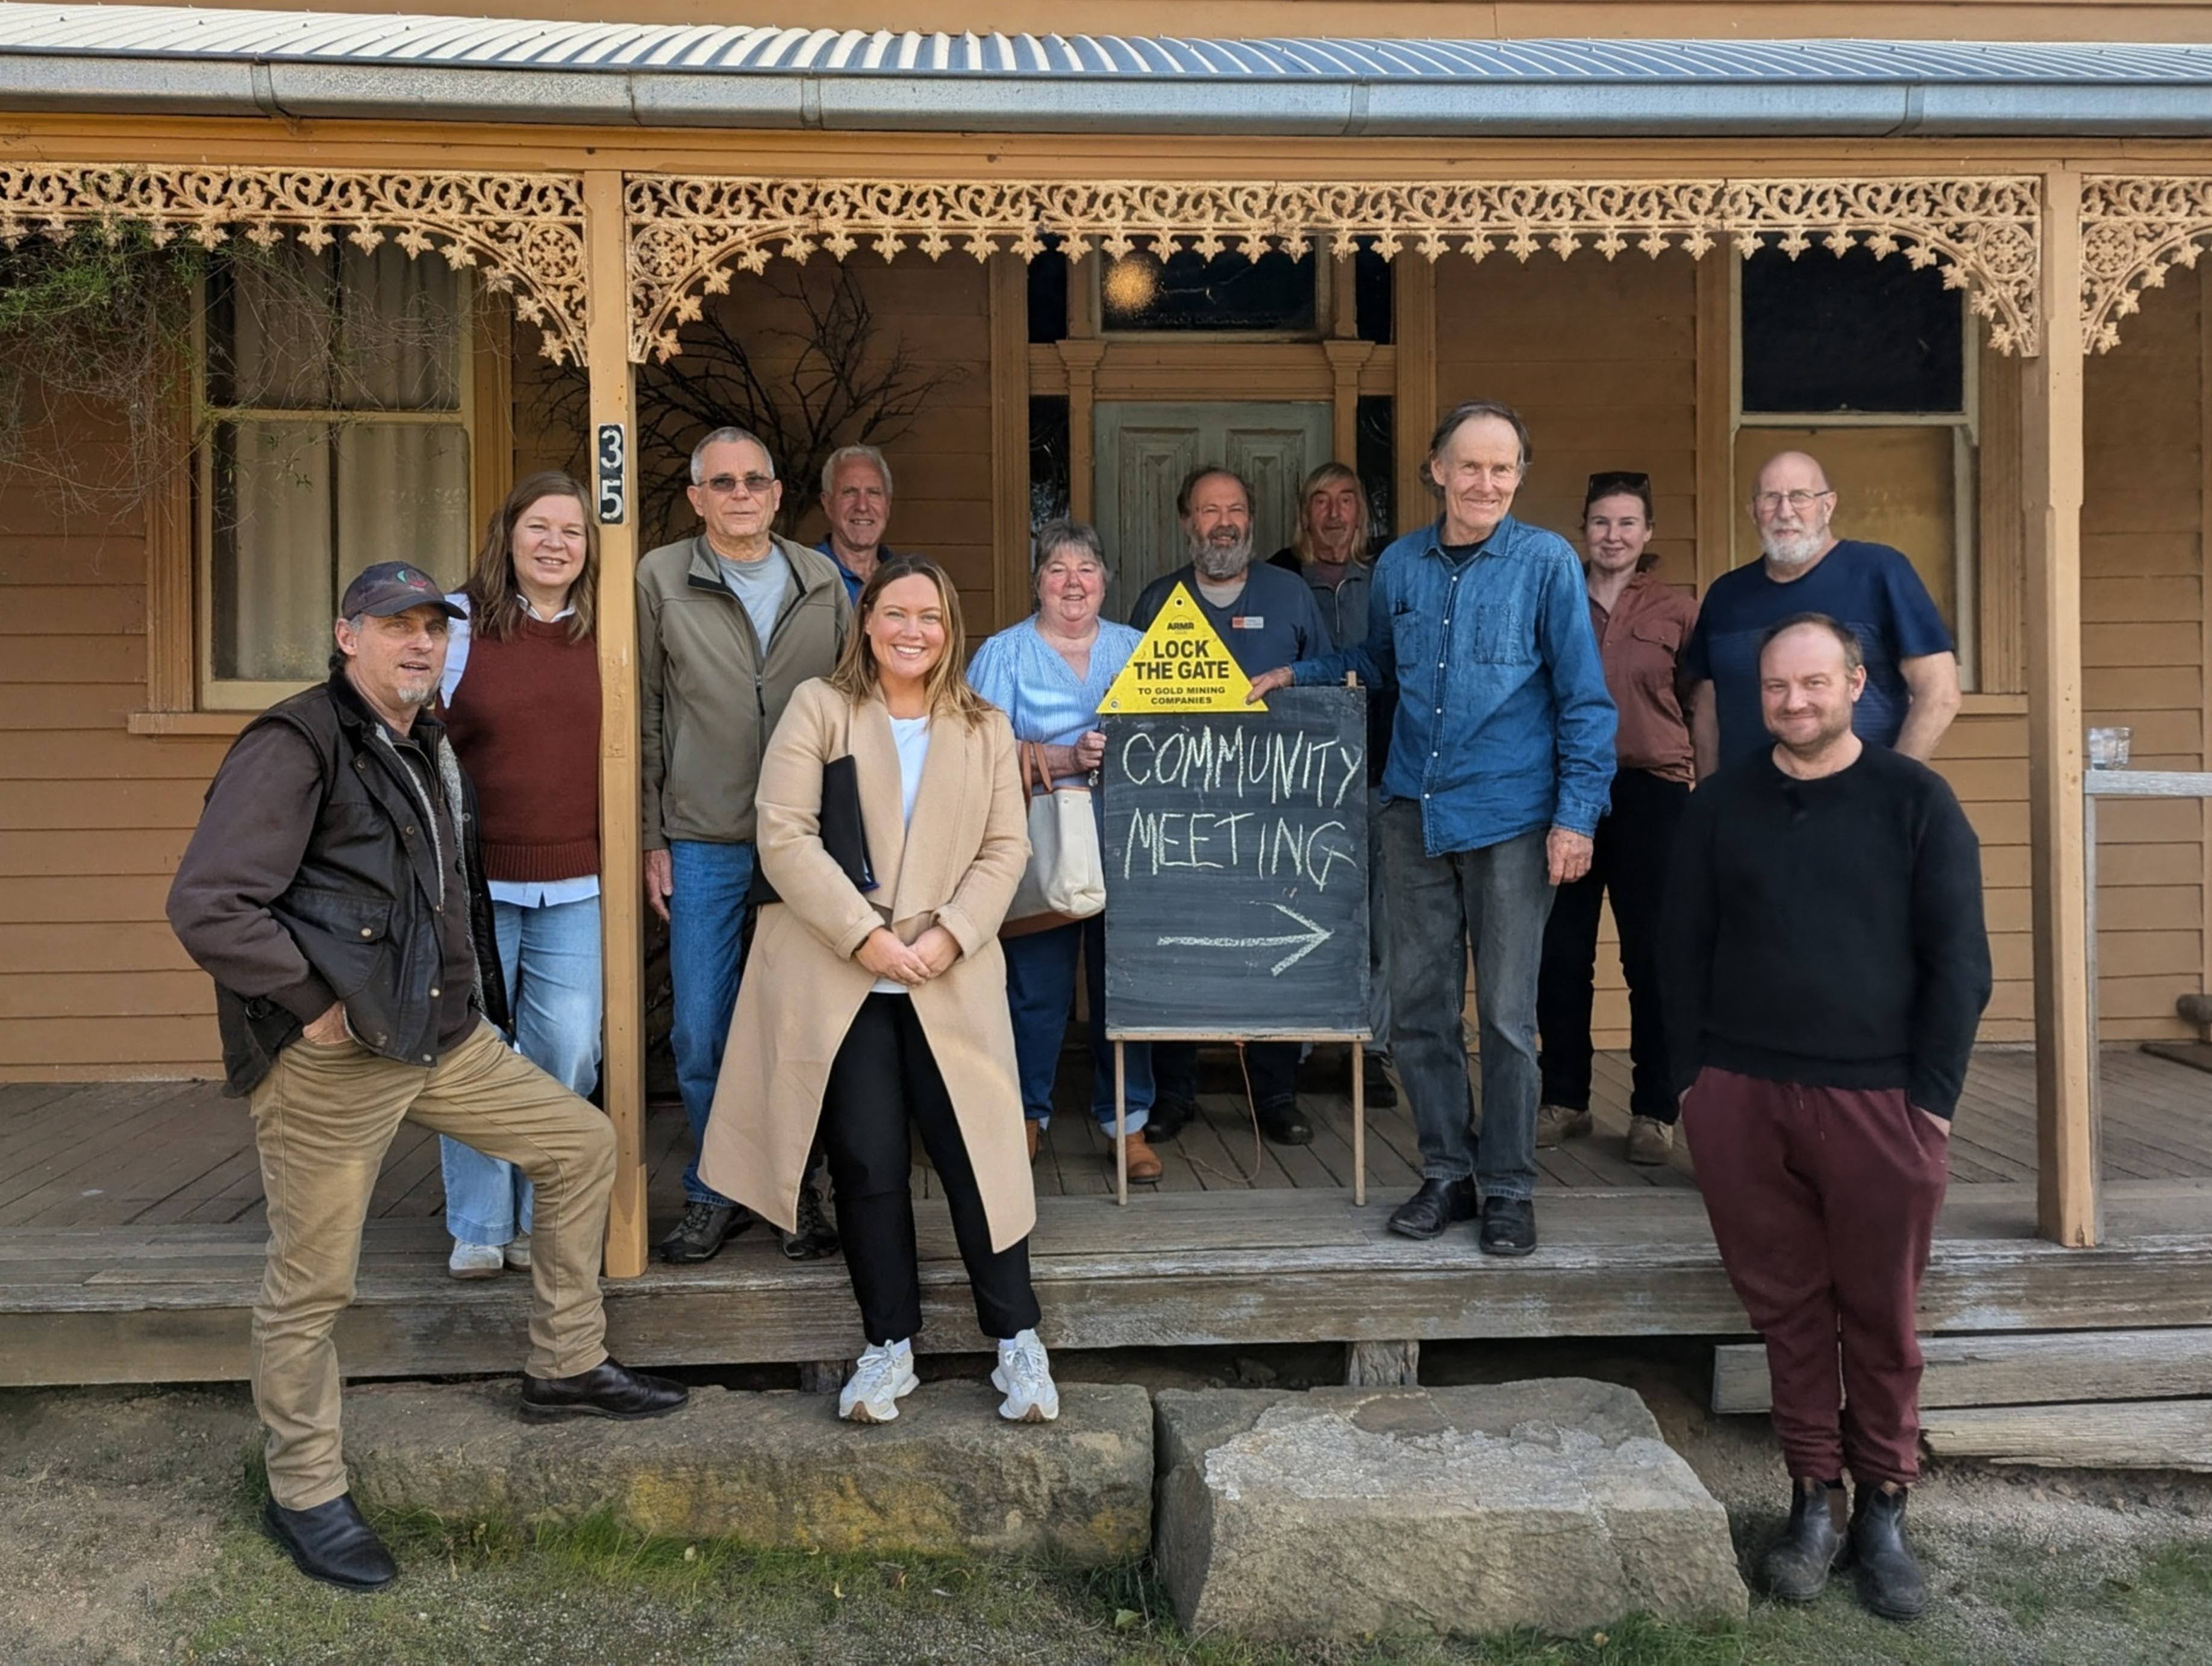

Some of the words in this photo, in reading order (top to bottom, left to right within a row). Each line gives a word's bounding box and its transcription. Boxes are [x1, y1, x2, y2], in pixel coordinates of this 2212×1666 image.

[601, 429, 622, 519] 35
[1134, 662, 1173, 680] THE
[1178, 661, 1229, 679] GATE
[1153, 640, 1210, 659] LOCK
[1122, 725, 1363, 807] COMMUNITY
[1124, 808, 1357, 892] MEETING
